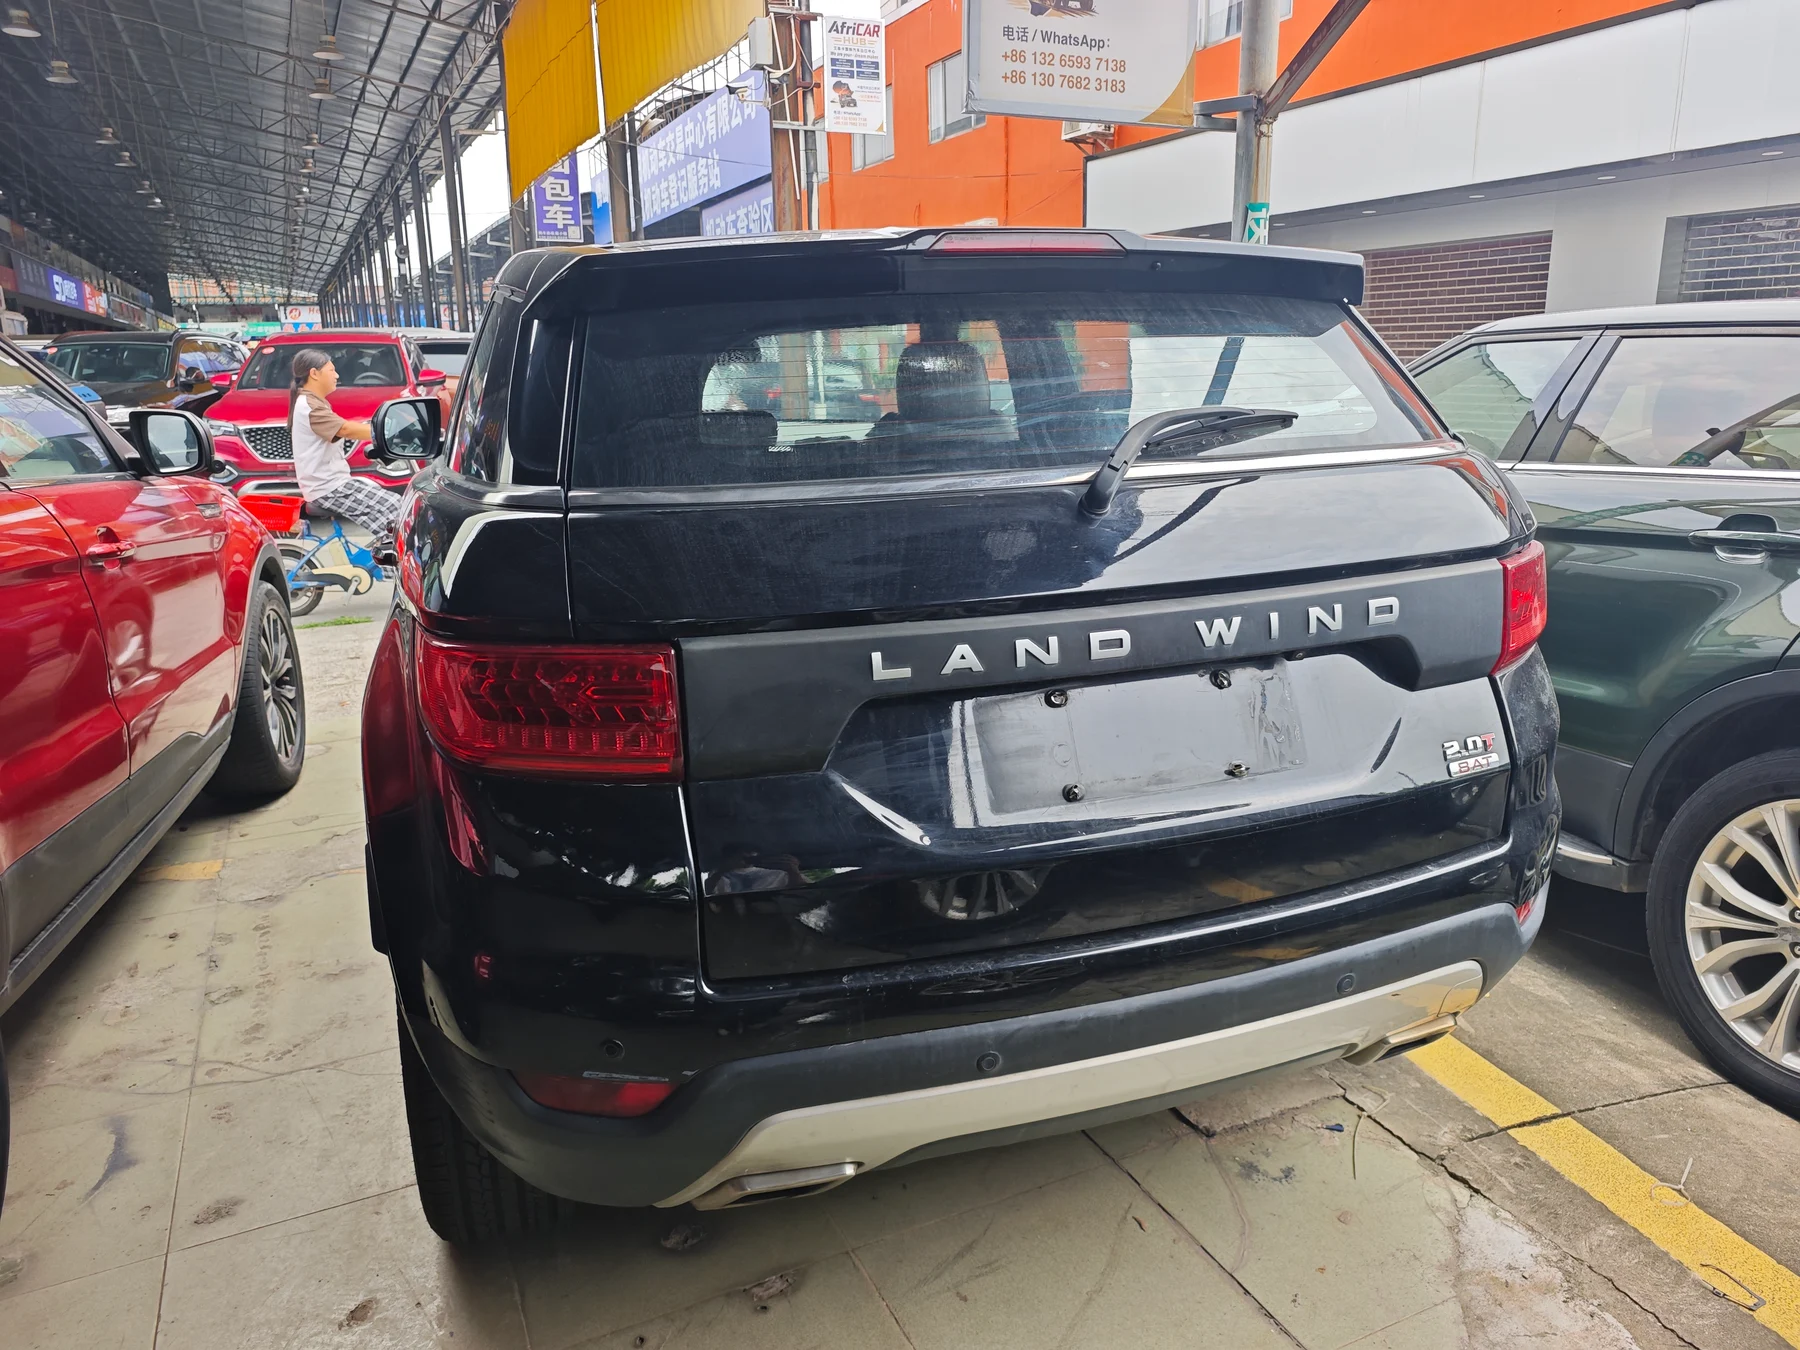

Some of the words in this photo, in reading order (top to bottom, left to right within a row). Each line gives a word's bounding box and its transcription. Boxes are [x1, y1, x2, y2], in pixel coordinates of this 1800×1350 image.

[828, 21, 880, 37] AfriCAR
[843, 37, 866, 45] HUB
[1002, 25, 1029, 42] 电话
[1032, 29, 1038, 41] /
[1040, 30, 1111, 51] WhatsApp:
[1001, 49, 1027, 64] +86
[1032, 51, 1055, 66] 132
[1059, 54, 1091, 70] 6593
[1095, 57, 1126, 73] 7138
[1001, 70, 1027, 85] +86
[1032, 72, 1055, 87] 130
[1059, 74, 1091, 90] 7682
[1094, 78, 1126, 93] 3183
[637, 76, 757, 184] 机动车交易中心有限公司
[871, 629, 1132, 680] LAND
[1194, 596, 1399, 647] WIND
[1442, 733, 1495, 761] 2.0T
